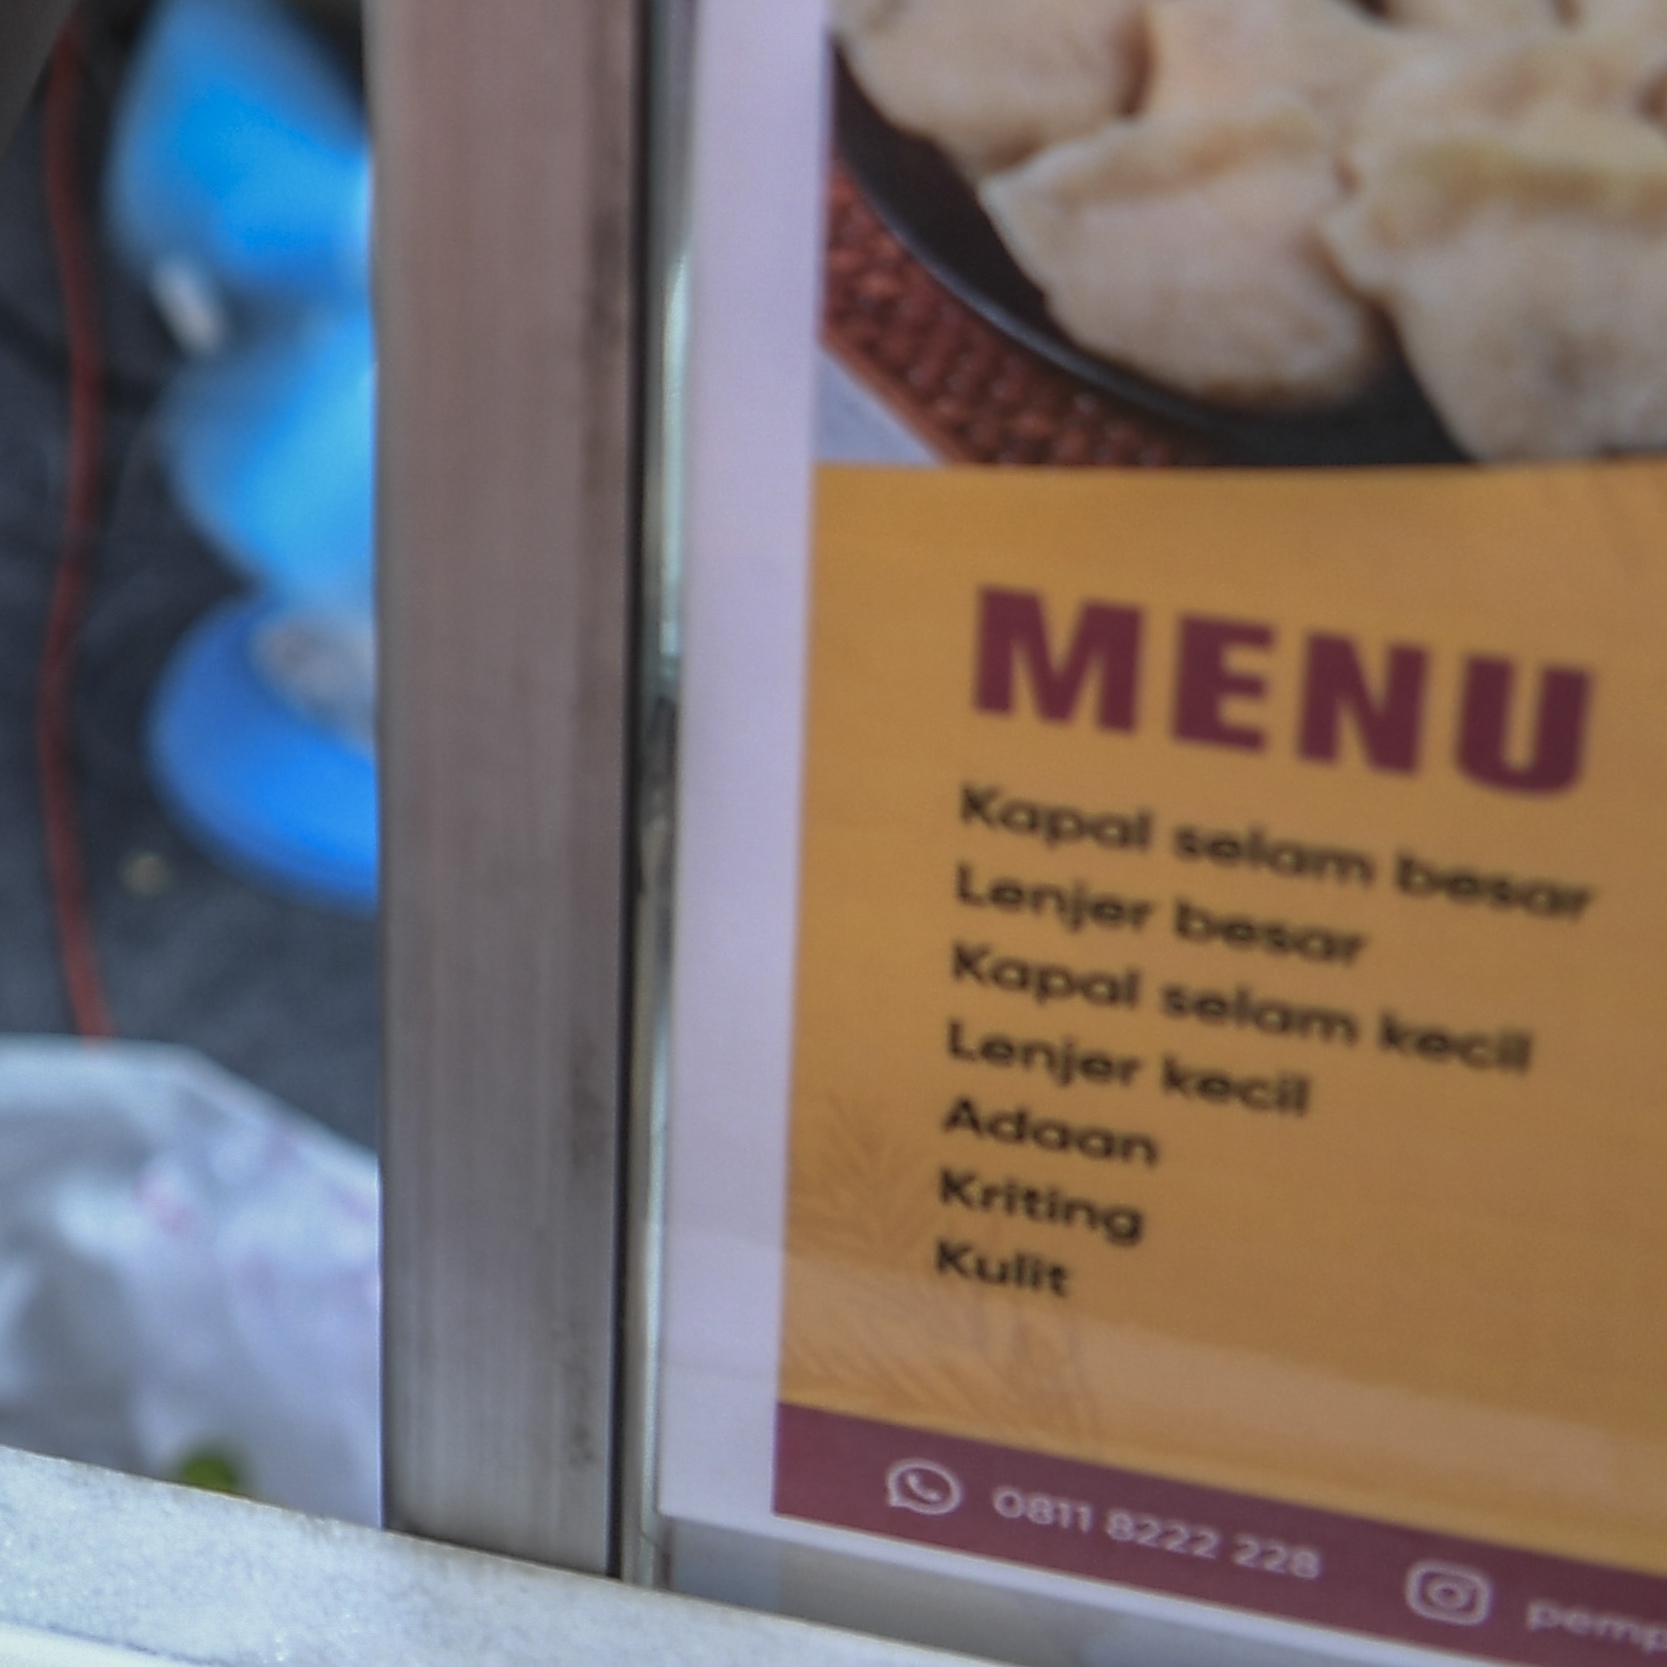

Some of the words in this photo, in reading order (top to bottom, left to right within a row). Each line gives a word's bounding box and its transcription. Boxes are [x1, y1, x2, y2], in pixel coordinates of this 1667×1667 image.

[973, 584, 1592, 796] MENU
[960, 781, 1154, 850] Kapal
[1174, 825, 1375, 890] selam
[1394, 848, 1594, 921] besar
[957, 860, 1154, 932] Lenjer
[1175, 898, 1369, 968] besar
[951, 939, 1141, 1005] Kapal
[1162, 981, 1360, 1046] selam
[1378, 1011, 1533, 1076] kecil
[947, 1018, 1142, 1088] Lenjer
[1161, 1056, 1311, 1117] kecil
[943, 1097, 1161, 1166] Adaan
[940, 1169, 1145, 1247] Kriting
[936, 1240, 1069, 1299] Kulit
[992, 1486, 1092, 1533] 0811
[1106, 1508, 1218, 1561] 8222
[1231, 1536, 1321, 1580] 228
